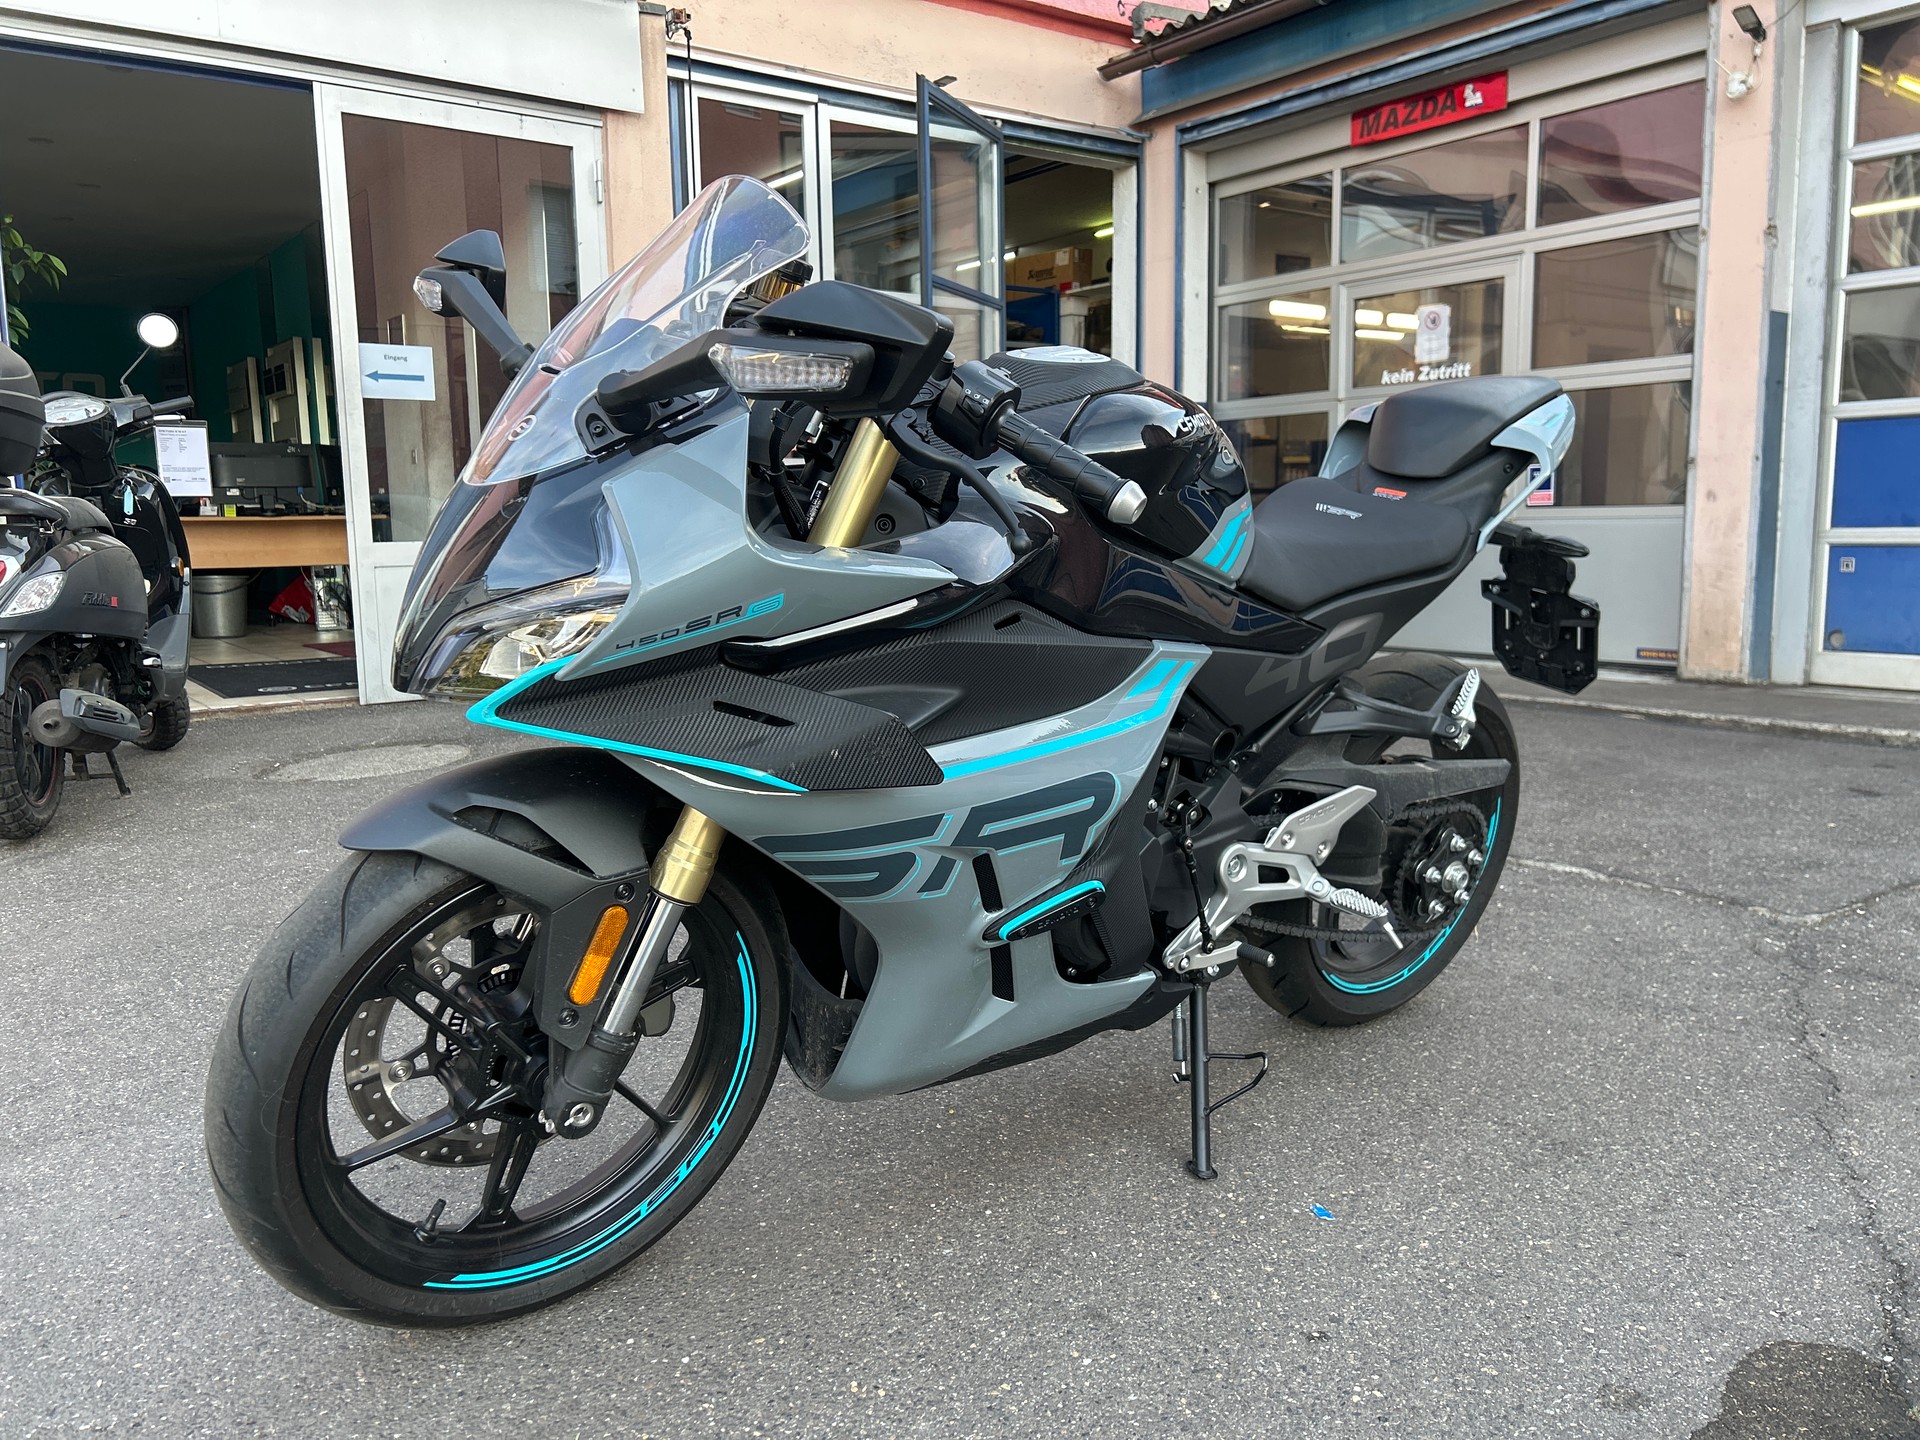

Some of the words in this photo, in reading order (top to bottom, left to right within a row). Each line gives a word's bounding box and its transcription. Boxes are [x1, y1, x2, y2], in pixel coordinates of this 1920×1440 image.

[1359, 89, 1457, 139] MAZDA
[383, 354, 408, 362] Eingang
[1417, 362, 1472, 381] Zutritt
